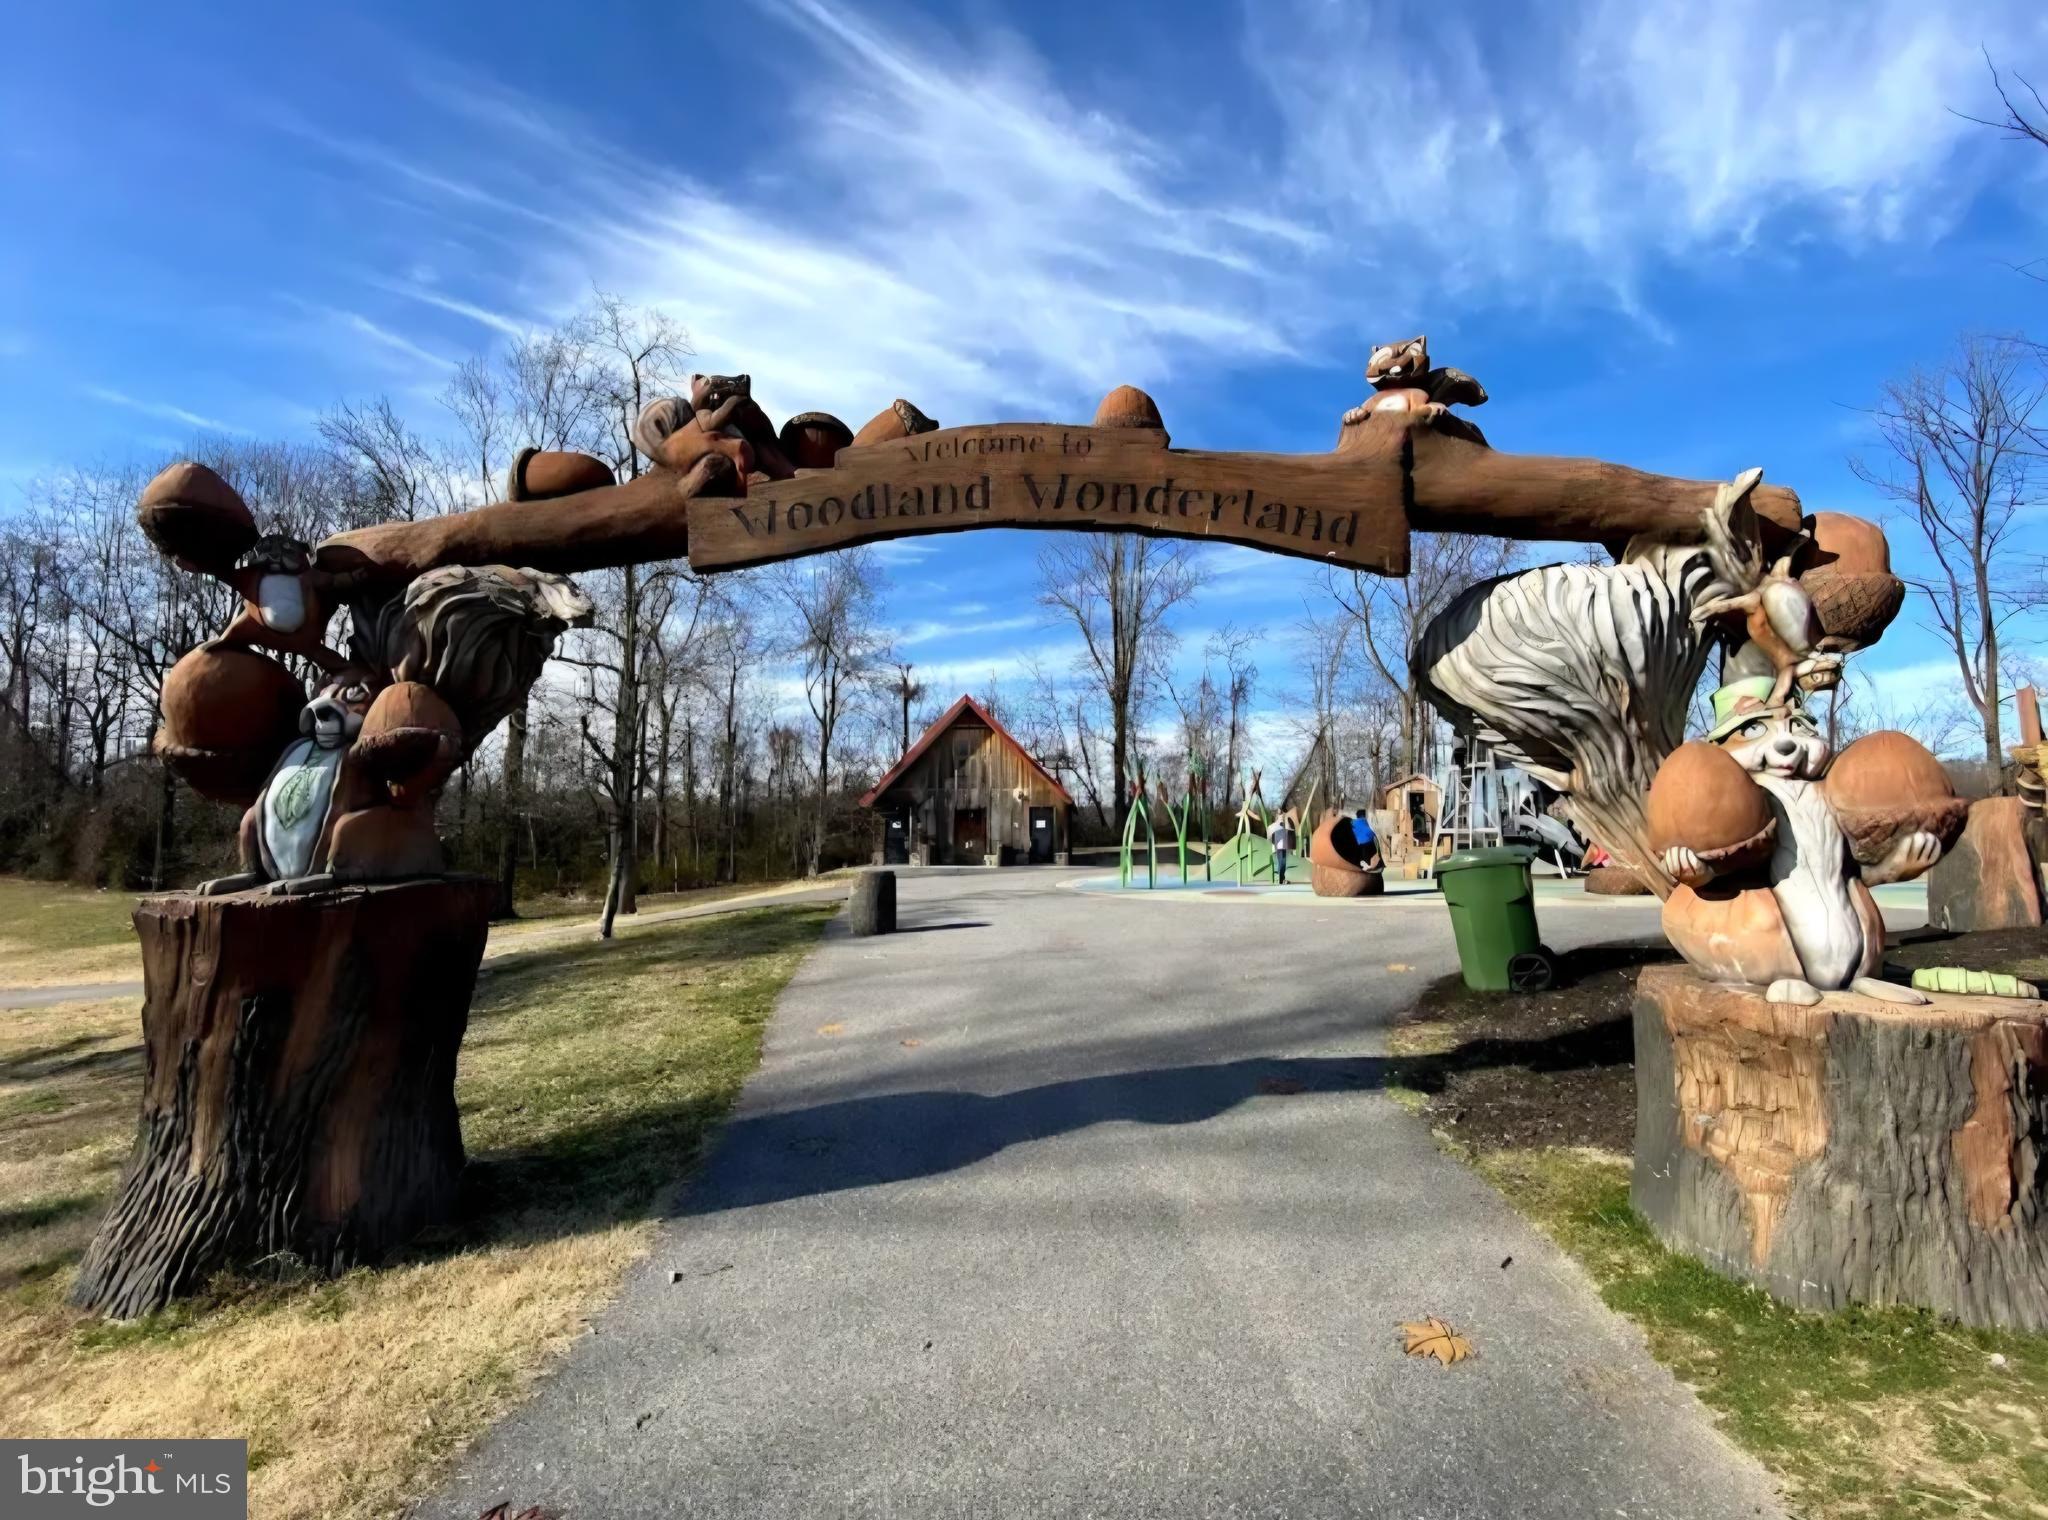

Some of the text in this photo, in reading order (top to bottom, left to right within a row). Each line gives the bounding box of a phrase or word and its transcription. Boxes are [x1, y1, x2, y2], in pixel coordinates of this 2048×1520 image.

[903, 432, 1092, 462] Welcome to
[728, 473, 1361, 547] Woodland Wonderland
